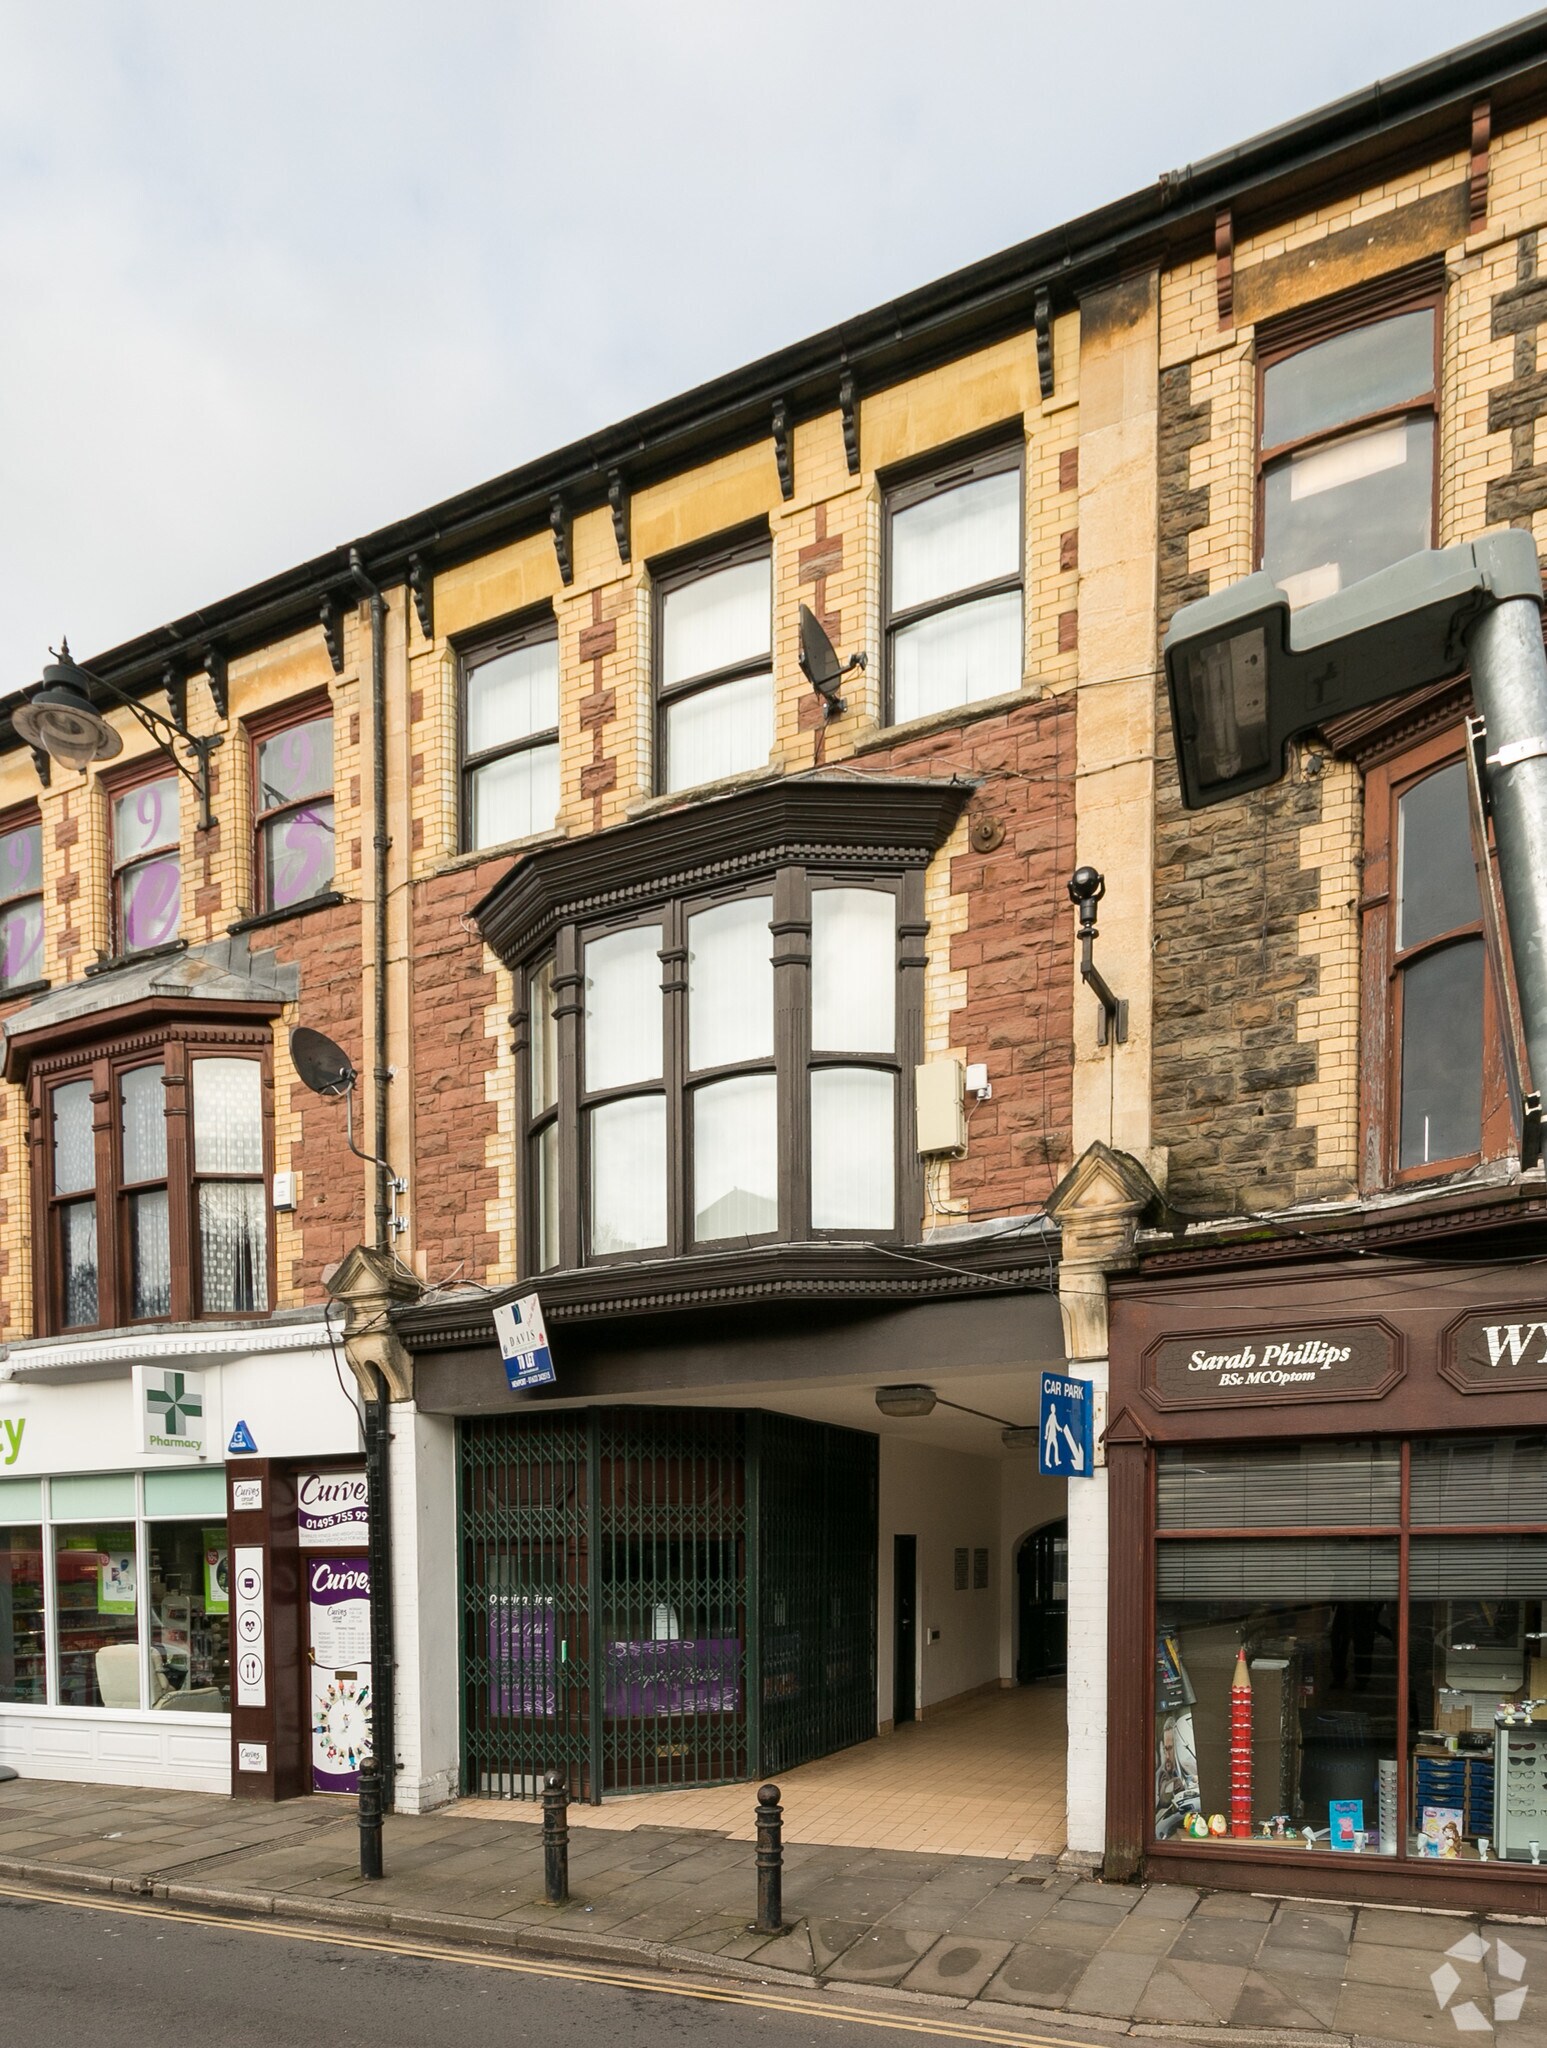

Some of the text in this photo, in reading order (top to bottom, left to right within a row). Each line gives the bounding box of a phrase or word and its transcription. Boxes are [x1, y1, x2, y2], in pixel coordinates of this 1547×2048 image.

[509, 1330, 535, 1347] DAVIS
[1187, 1340, 1352, 1371] Sarah Phillips
[1219, 1369, 1316, 1387] BSc MCOptom
[1044, 1379, 1084, 1400] CAR PARK
[0, 1418, 26, 1465] y
[150, 1435, 202, 1451] Pharmacy
[235, 1484, 260, 1498] Curves
[301, 1474, 369, 1506] Curve
[306, 1516, 334, 1529] 01495
[335, 1510, 354, 1524] 755
[312, 1564, 371, 1594] Curve
